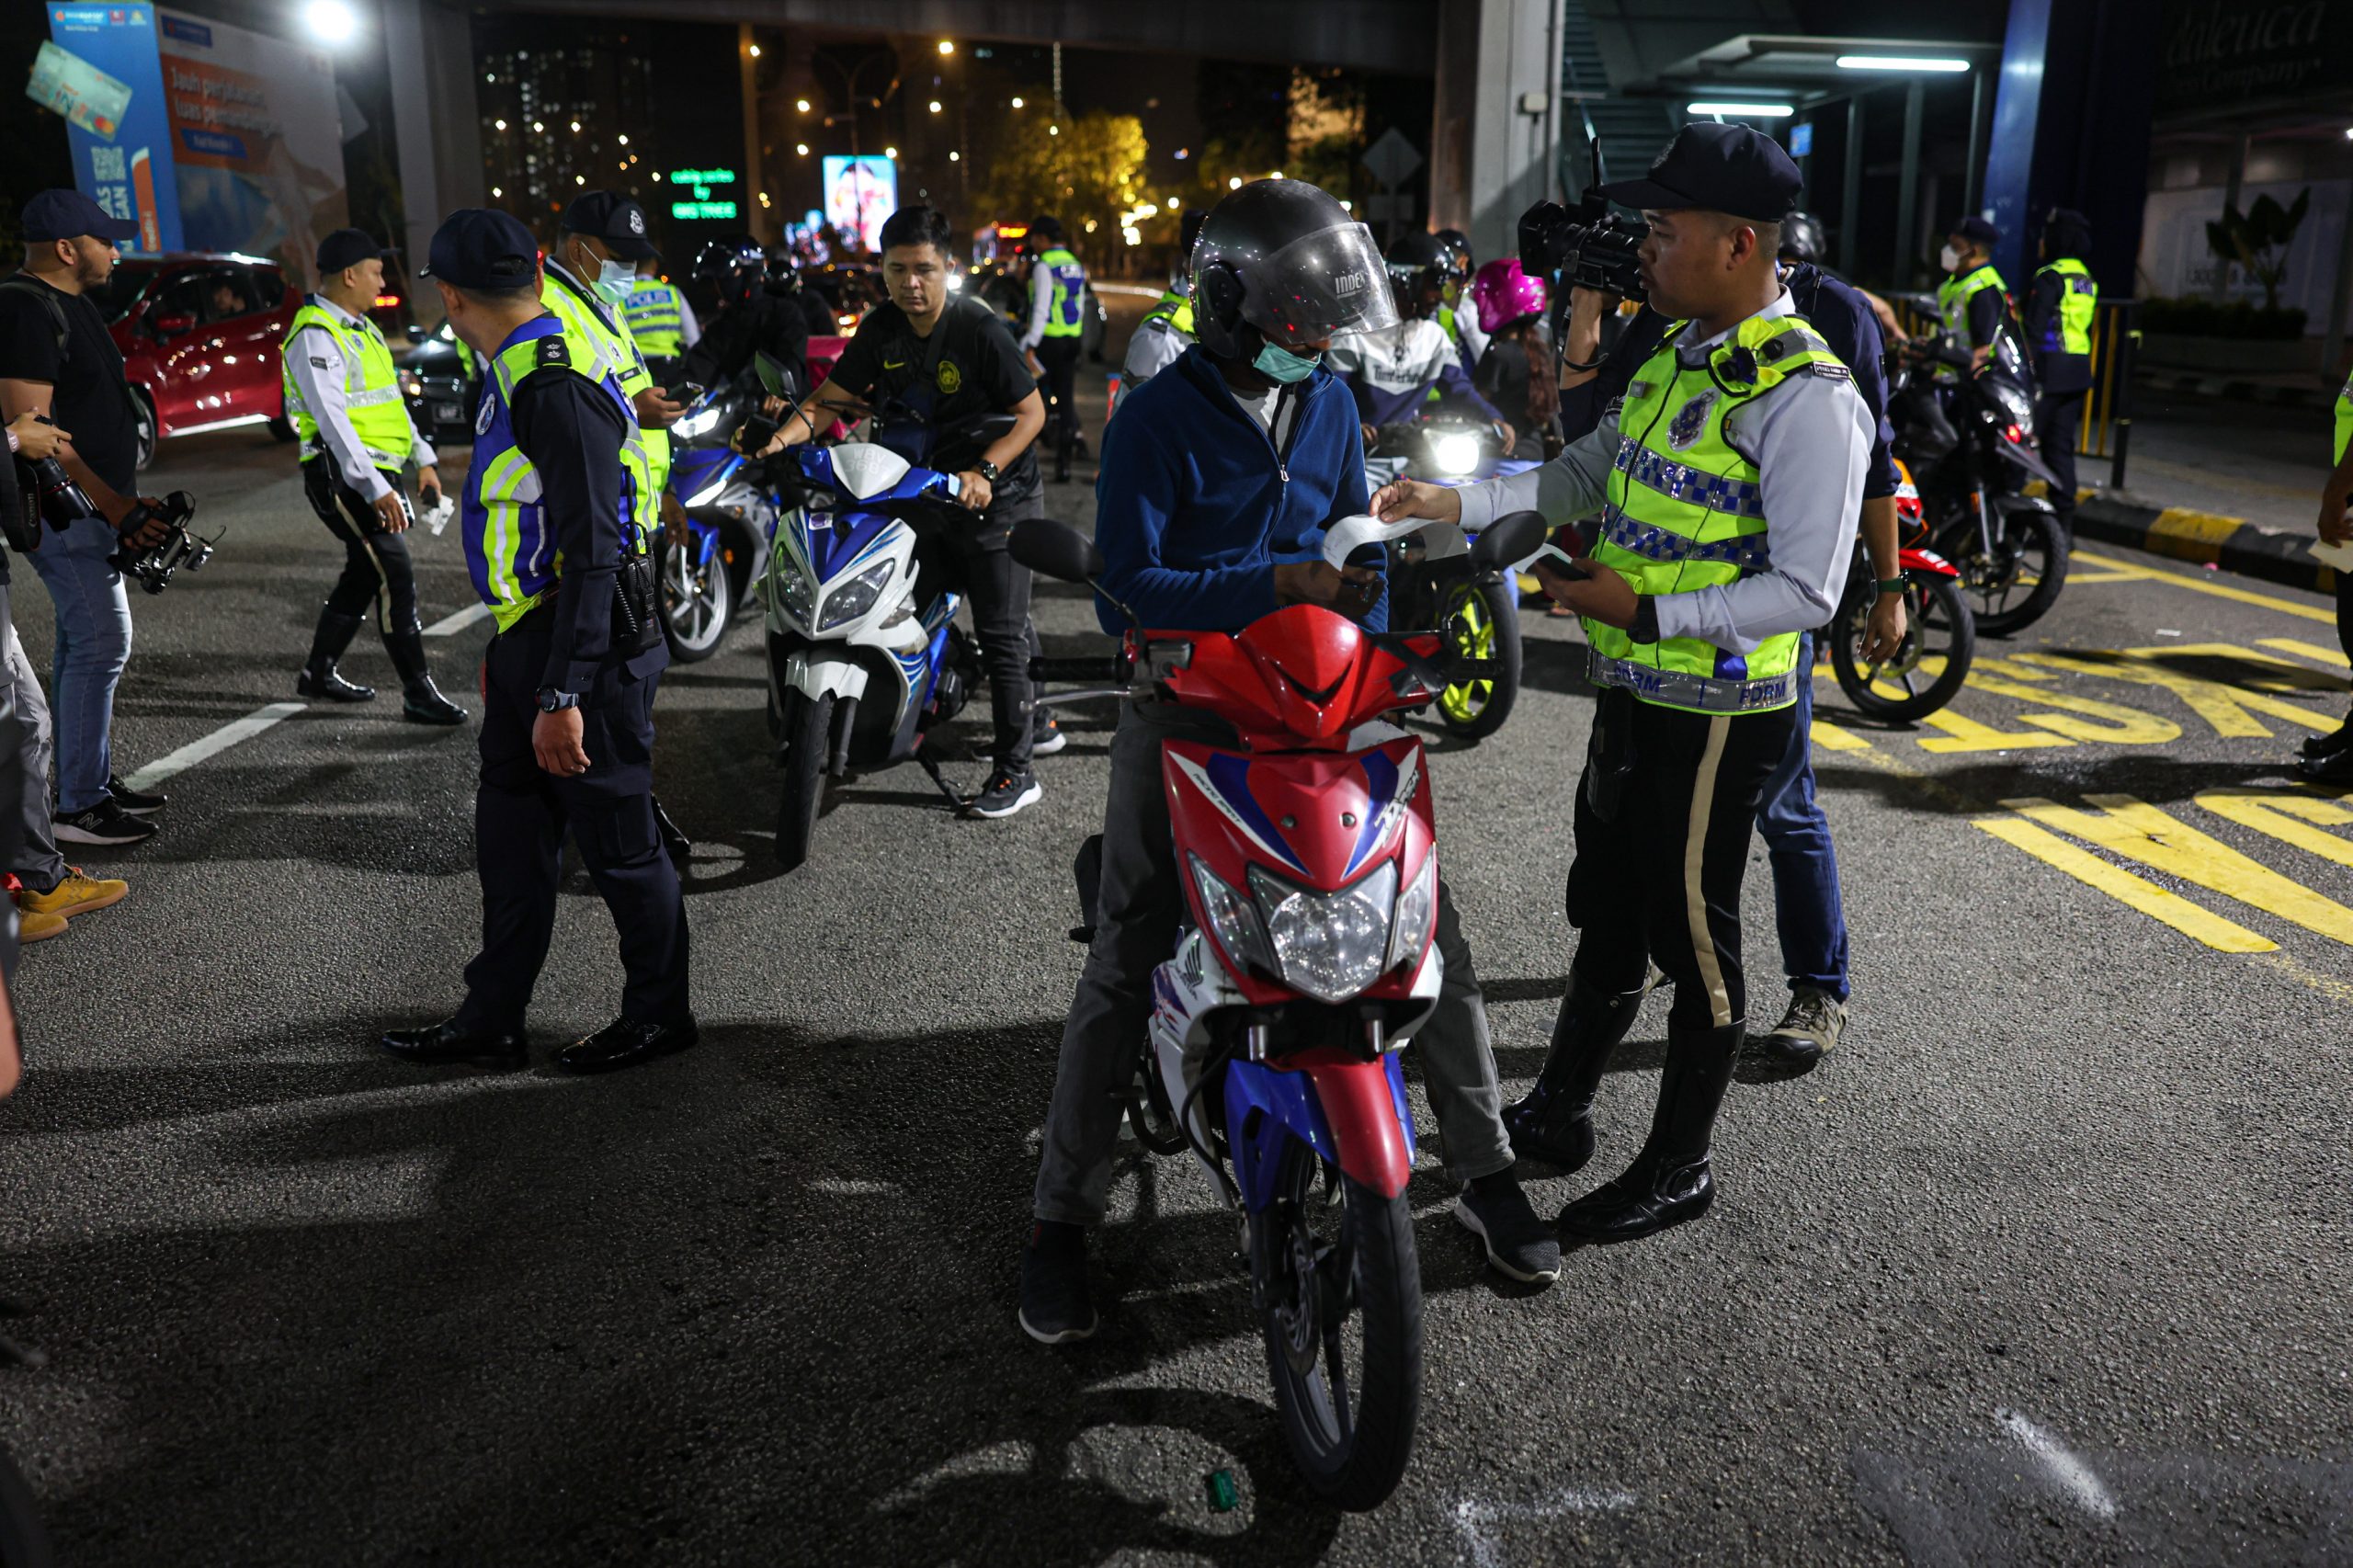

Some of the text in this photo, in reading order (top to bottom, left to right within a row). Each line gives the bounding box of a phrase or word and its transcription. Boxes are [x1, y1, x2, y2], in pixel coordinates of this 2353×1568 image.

[1335, 271, 1366, 294] INDEX
[627, 290, 672, 307] POLIS
[1613, 666, 1662, 693] PDRM
[1738, 681, 1787, 705] PDRM
